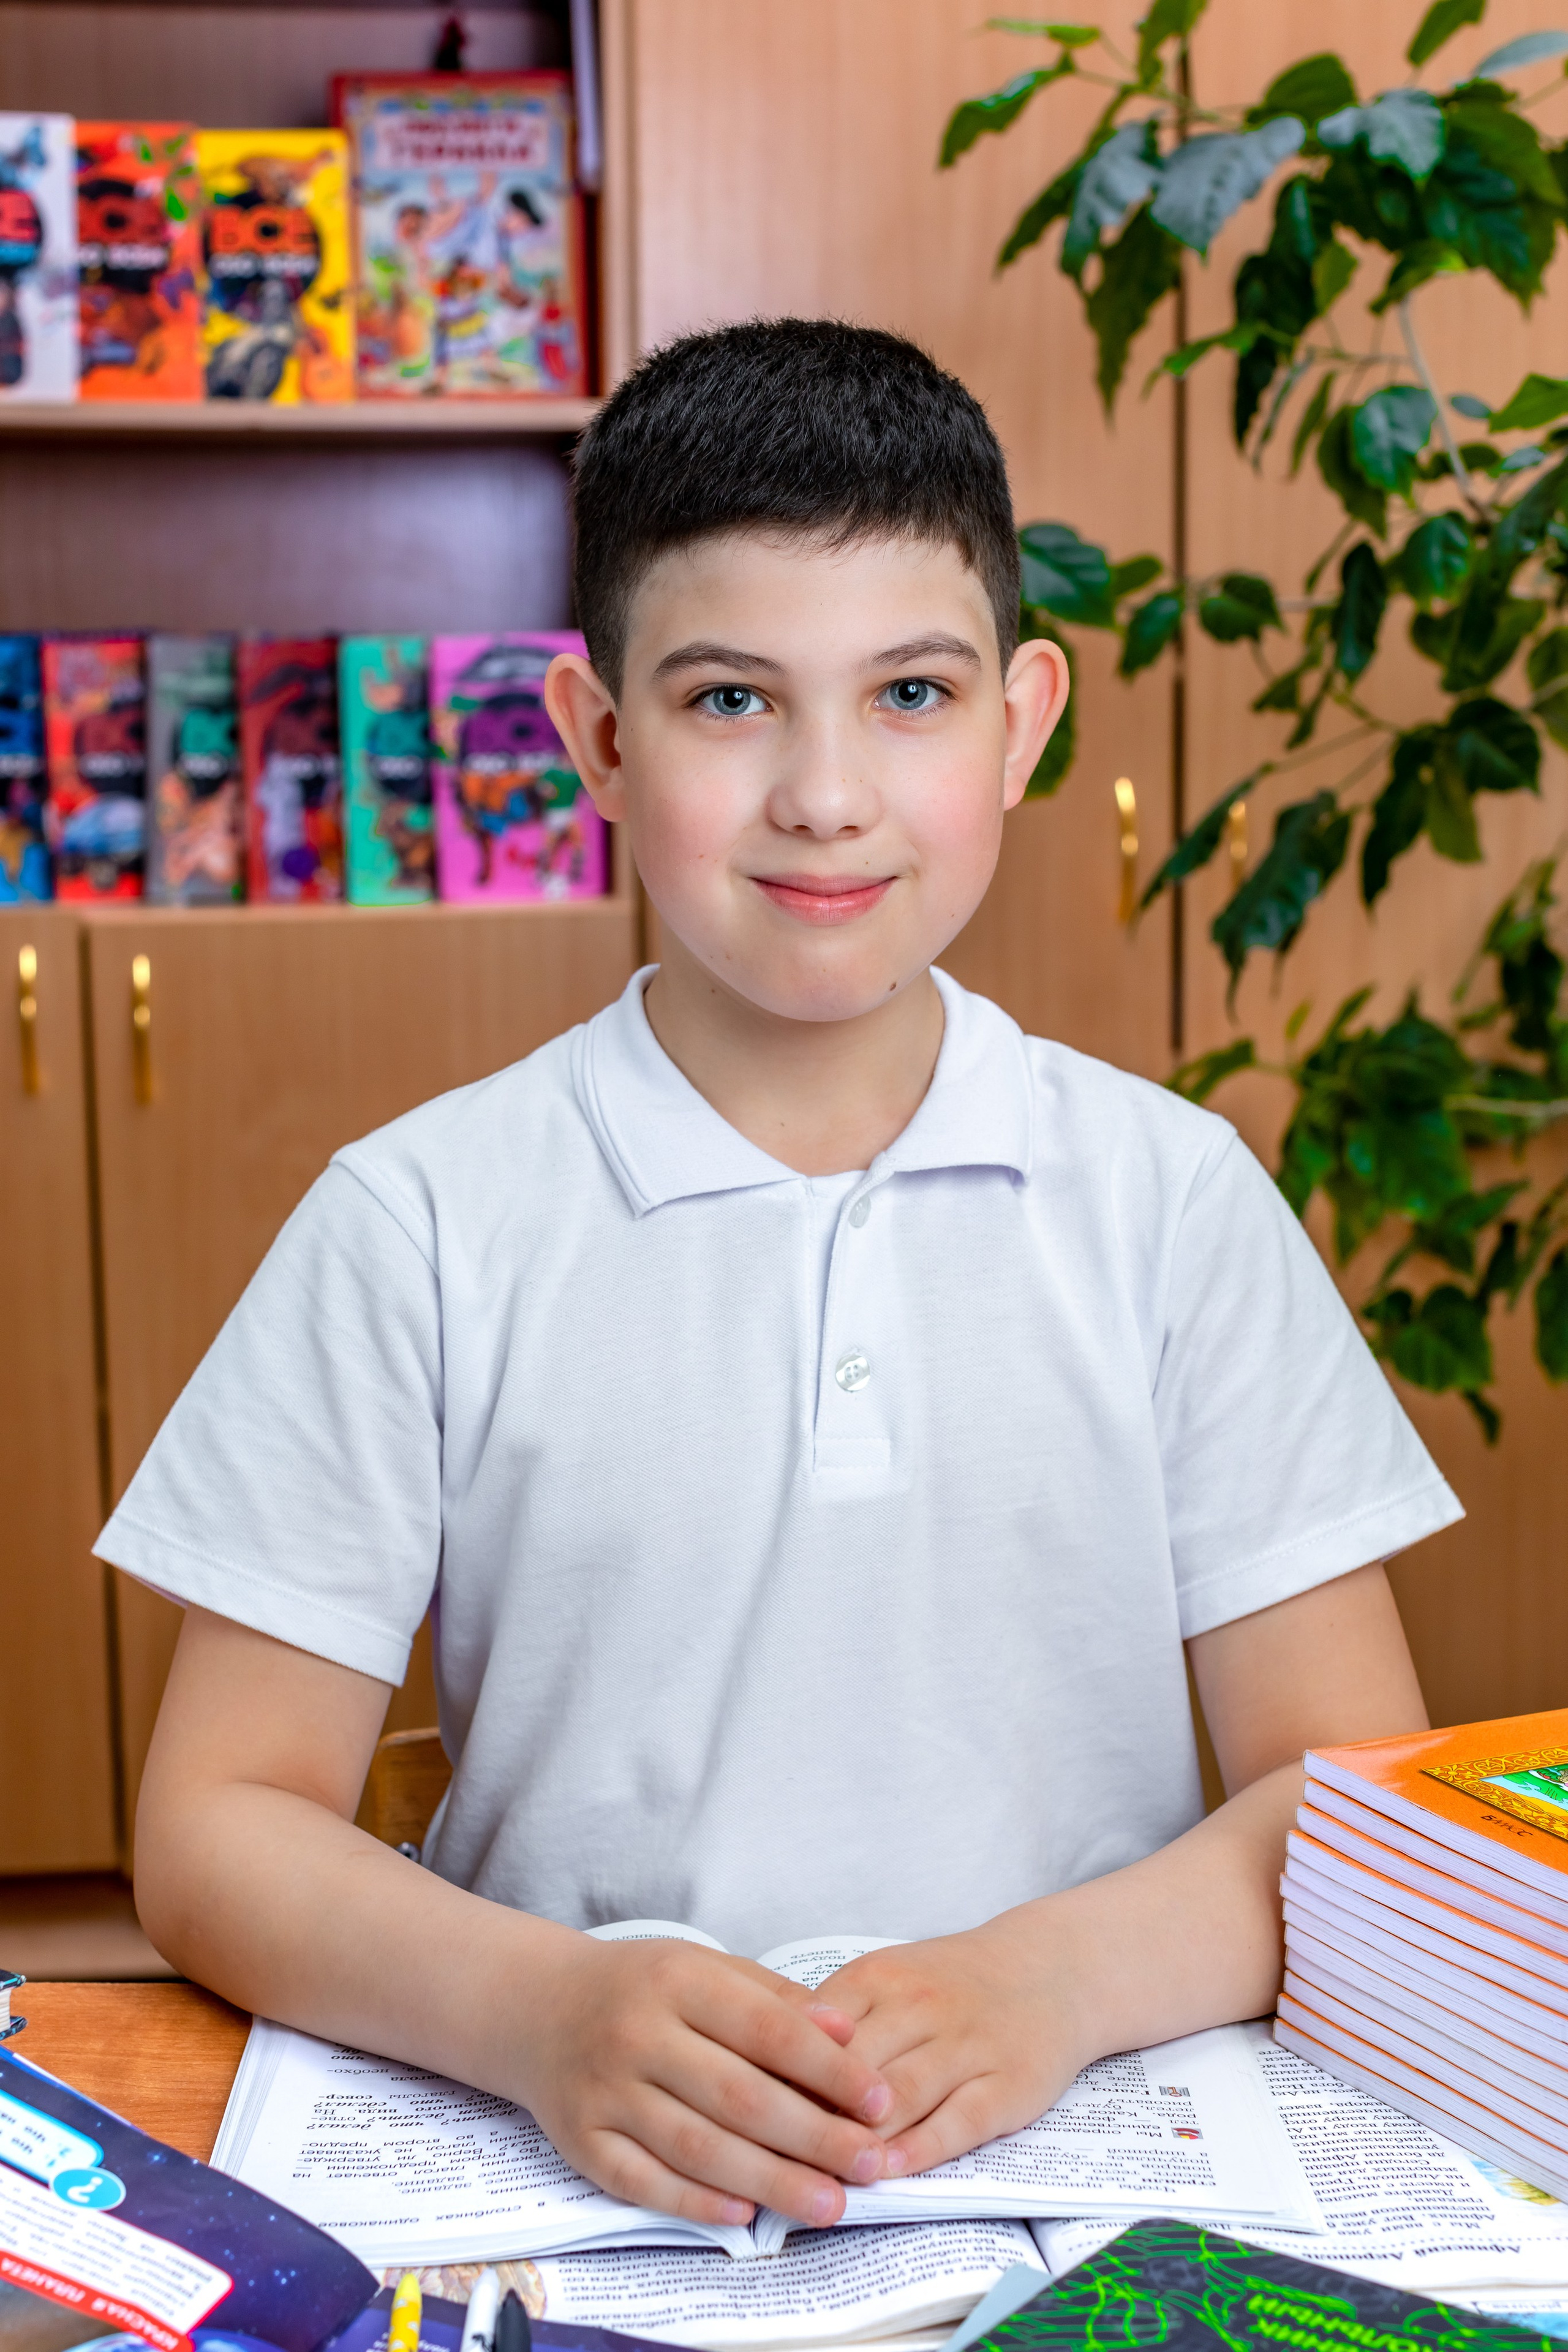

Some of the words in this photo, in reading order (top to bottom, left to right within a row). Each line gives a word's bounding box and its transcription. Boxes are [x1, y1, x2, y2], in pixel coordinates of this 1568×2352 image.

[388, 2090, 456, 2100] глаголы
[367, 2113, 445, 2122] делать?
[440, 2108, 518, 2126] делать?
[1023, 2126, 1121, 2135] определили
[1040, 2120, 1161, 2130] единственного
[383, 2138, 440, 2147] втором
[426, 2141, 476, 2152] глагол
[432, 2147, 483, 2158] Верно
[450, 2151, 506, 2164] втором
[326, 2160, 436, 2171] предложении
[413, 2165, 465, 2176] глагол
[1414, 2244, 1521, 2258] Афинский
